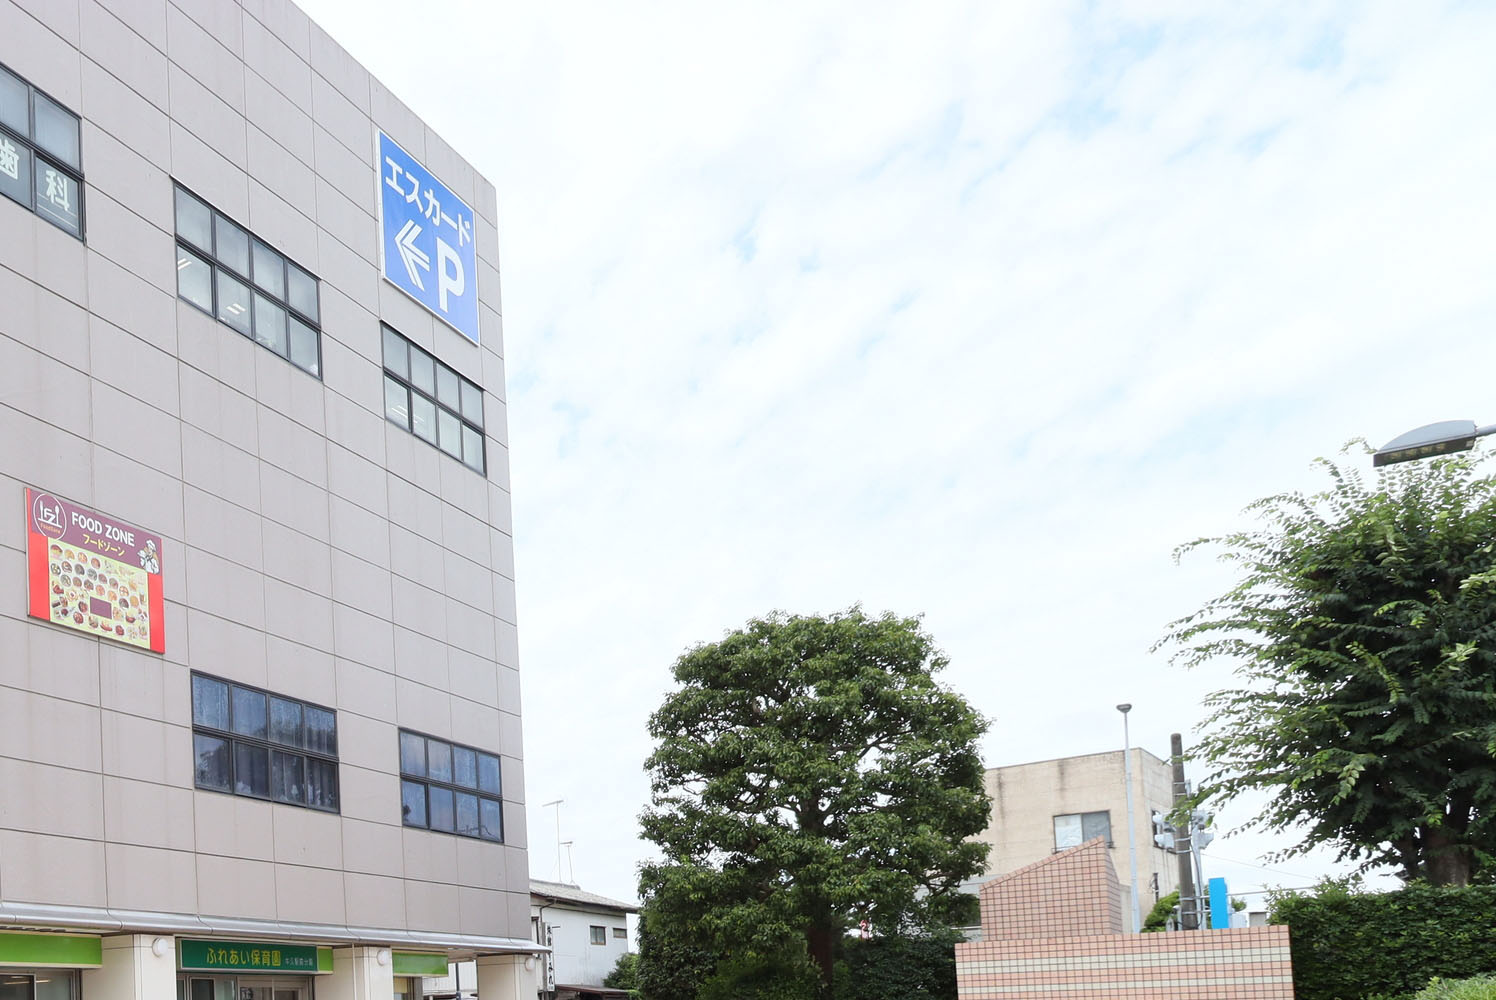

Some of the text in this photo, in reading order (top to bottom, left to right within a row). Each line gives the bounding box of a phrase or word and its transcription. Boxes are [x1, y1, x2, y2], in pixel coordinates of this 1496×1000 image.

[385, 155, 471, 247] エスカード
[436, 236, 465, 313] P
[71, 511, 135, 547] FOOD ZONE
[82, 533, 126, 557] フードゾーン
[206, 946, 281, 966] ふれあい保育園
